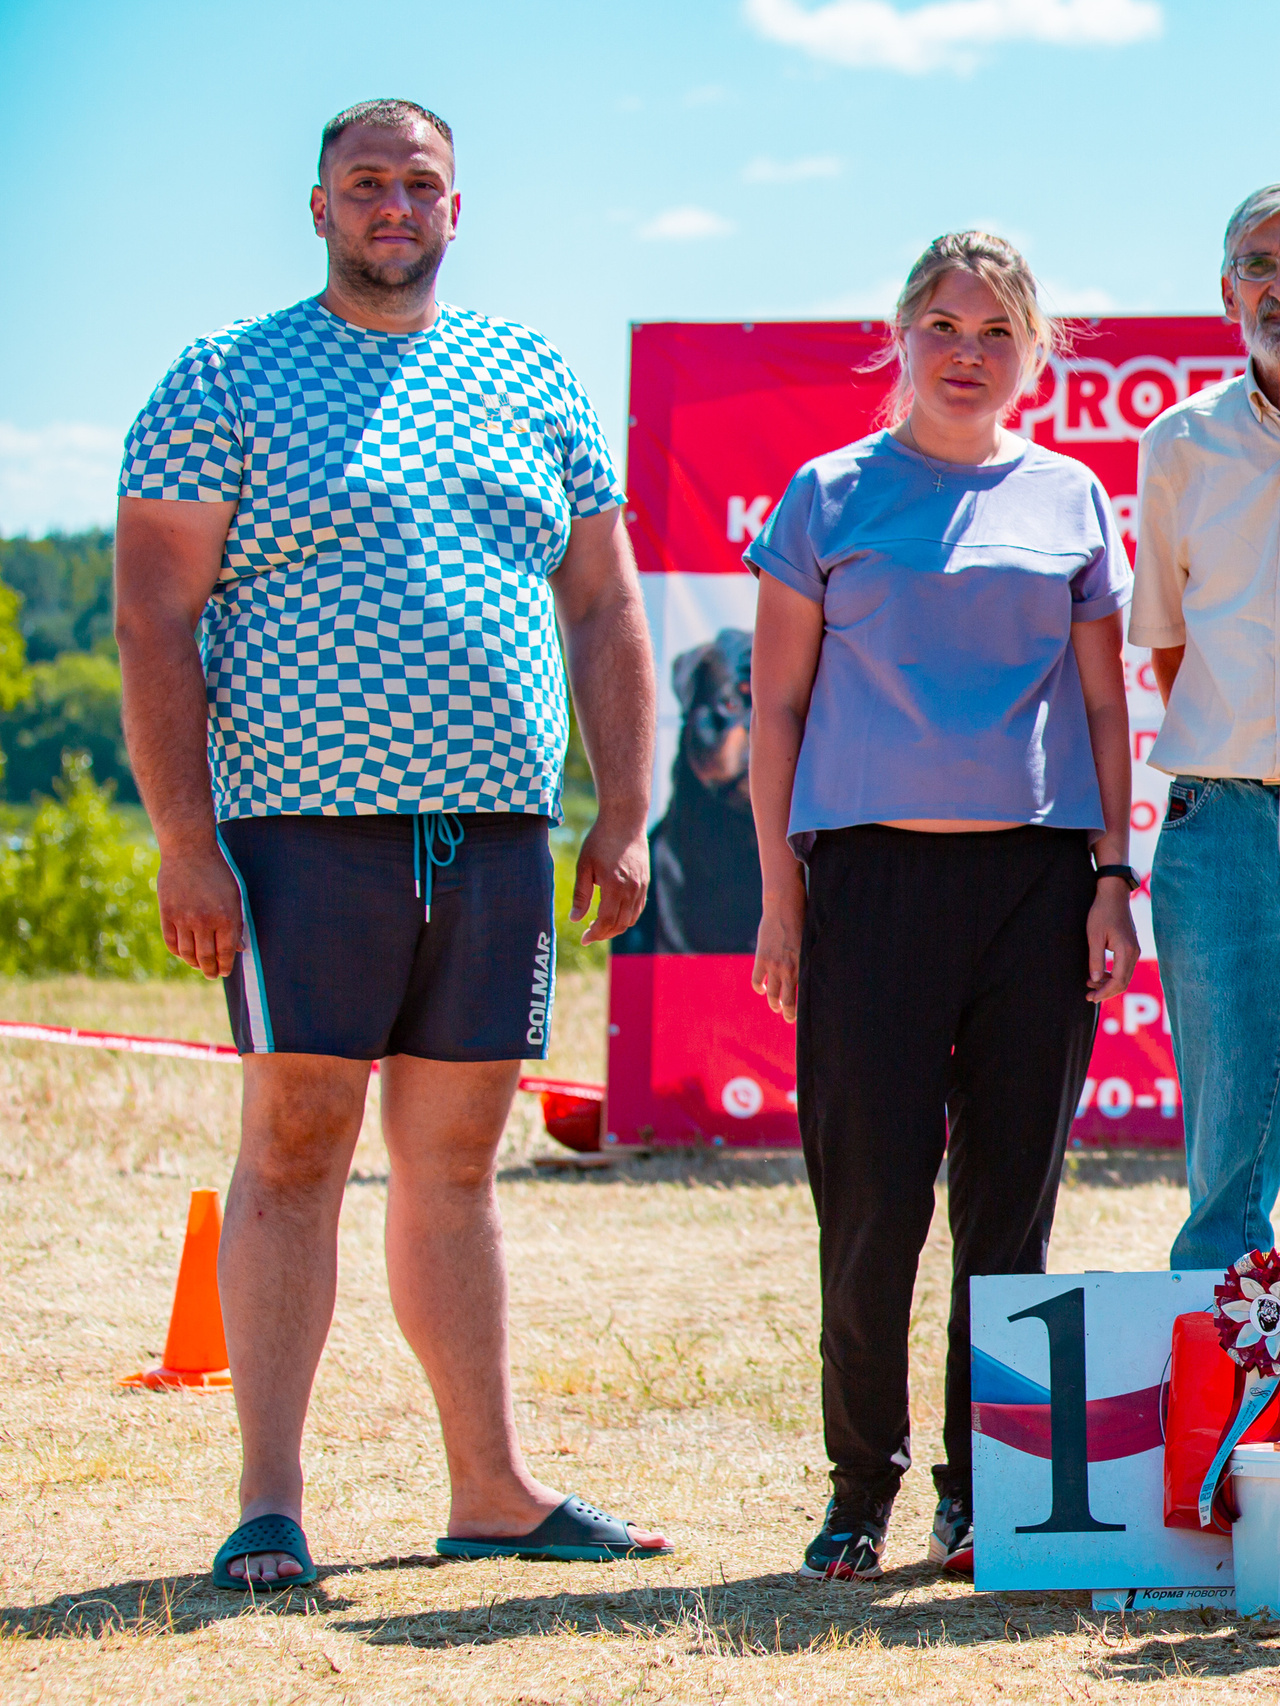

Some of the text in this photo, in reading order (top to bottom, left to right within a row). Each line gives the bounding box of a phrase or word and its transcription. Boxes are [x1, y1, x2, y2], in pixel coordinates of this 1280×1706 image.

[526, 931, 551, 1046] COLMAR
[1007, 1287, 1126, 1534] 1
[1142, 1589, 1184, 1600] Корма
[1186, 1589, 1228, 1598] нового
